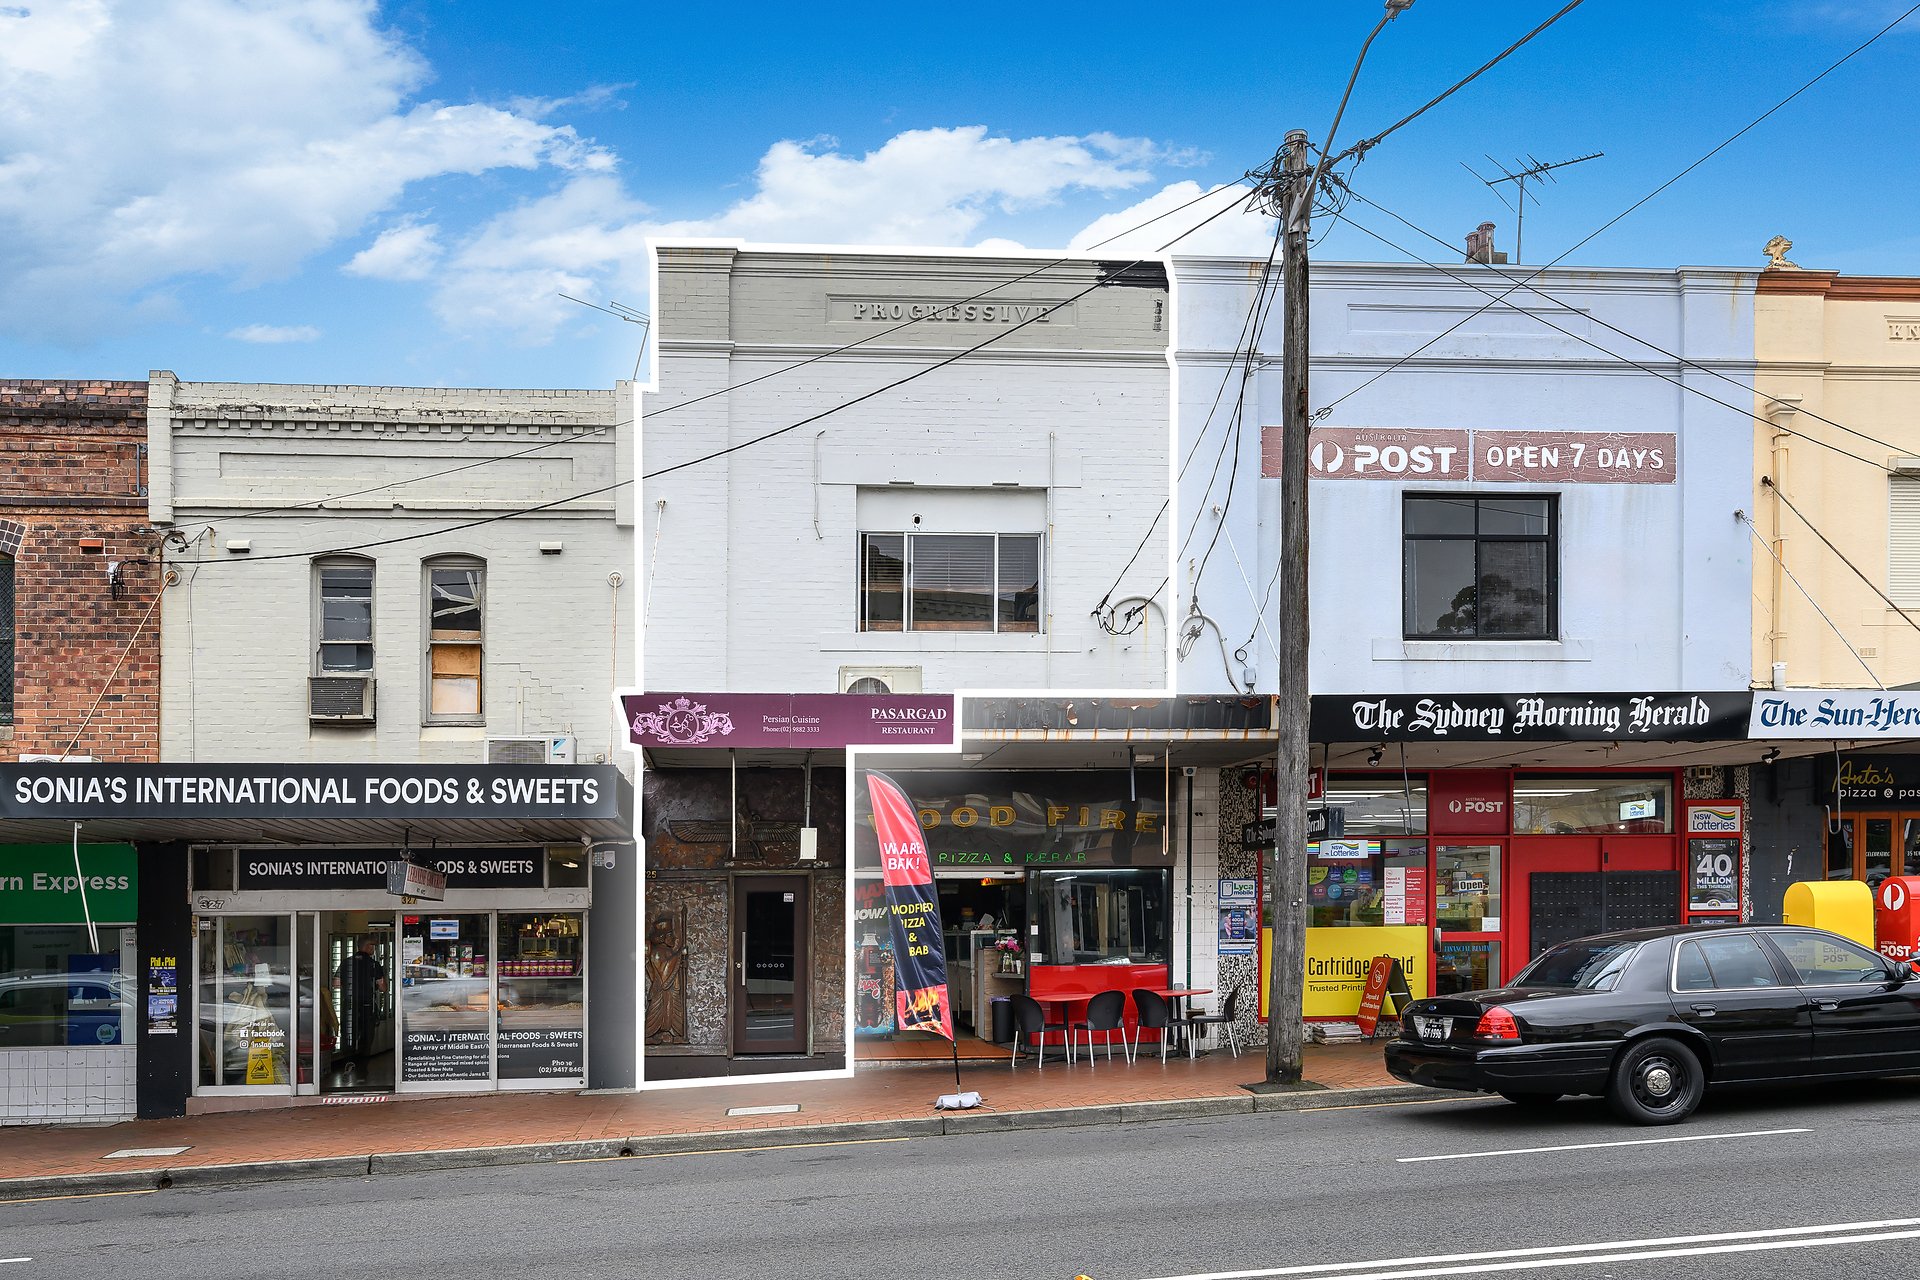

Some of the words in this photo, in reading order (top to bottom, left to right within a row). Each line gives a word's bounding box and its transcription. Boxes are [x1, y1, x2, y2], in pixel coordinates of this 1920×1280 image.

[853, 303, 1051, 322] PROGRESSIVE
[1355, 433, 1407, 442] AUSTRALIA
[1354, 445, 1457, 473] POST
[1486, 446, 1559, 468] OPEN
[1569, 443, 1587, 467] 7
[1598, 448, 1664, 469] DAYS
[870, 708, 947, 720] PASARGAD
[1352, 699, 1405, 735] The
[1408, 699, 1505, 735] Sydney
[1513, 698, 1621, 735] Morning
[1629, 696, 1710, 734] Herald
[1761, 699, 1808, 727] The
[763, 715, 790, 724] Persian
[791, 716, 820, 724] Cuisine
[882, 727, 935, 735] RESTAURANT
[15, 776, 128, 804] SONIA'S
[136, 777, 356, 804] INTERNATIONAL
[365, 777, 459, 804] FOODS
[466, 778, 485, 804] &
[491, 777, 599, 804] SWEETS
[1840, 787, 1877, 800] pizza
[1465, 801, 1504, 813] POST
[1048, 806, 1159, 833] FIRE
[1692, 820, 1736, 831] Lotteries
[938, 852, 993, 864] PIZZA
[1003, 853, 1013, 863] &
[1331, 849, 1359, 857] Lotteries
[249, 861, 304, 876] SONIA'S
[307, 860, 388, 875] INTERNATIO
[467, 860, 478, 874] &
[479, 860, 534, 874] SWEETS
[33, 872, 129, 893] Express
[1460, 881, 1483, 890] Open
[1696, 876, 1732, 885] MILLION
[1234, 883, 1253, 891] Lyca
[200, 900, 225, 910] 327
[908, 932, 918, 942] &
[1880, 944, 1912, 957] POST
[1823, 954, 1849, 964] POST
[1308, 957, 1370, 978] Cartridge
[1309, 984, 1339, 992] Trusted
[251, 1029, 285, 1037] facebook
[511, 1031, 541, 1040] FOODS
[549, 1031, 582, 1039] SWEETS
[251, 1041, 285, 1050] Instagram
[538, 1066, 552, 1074] (02)
